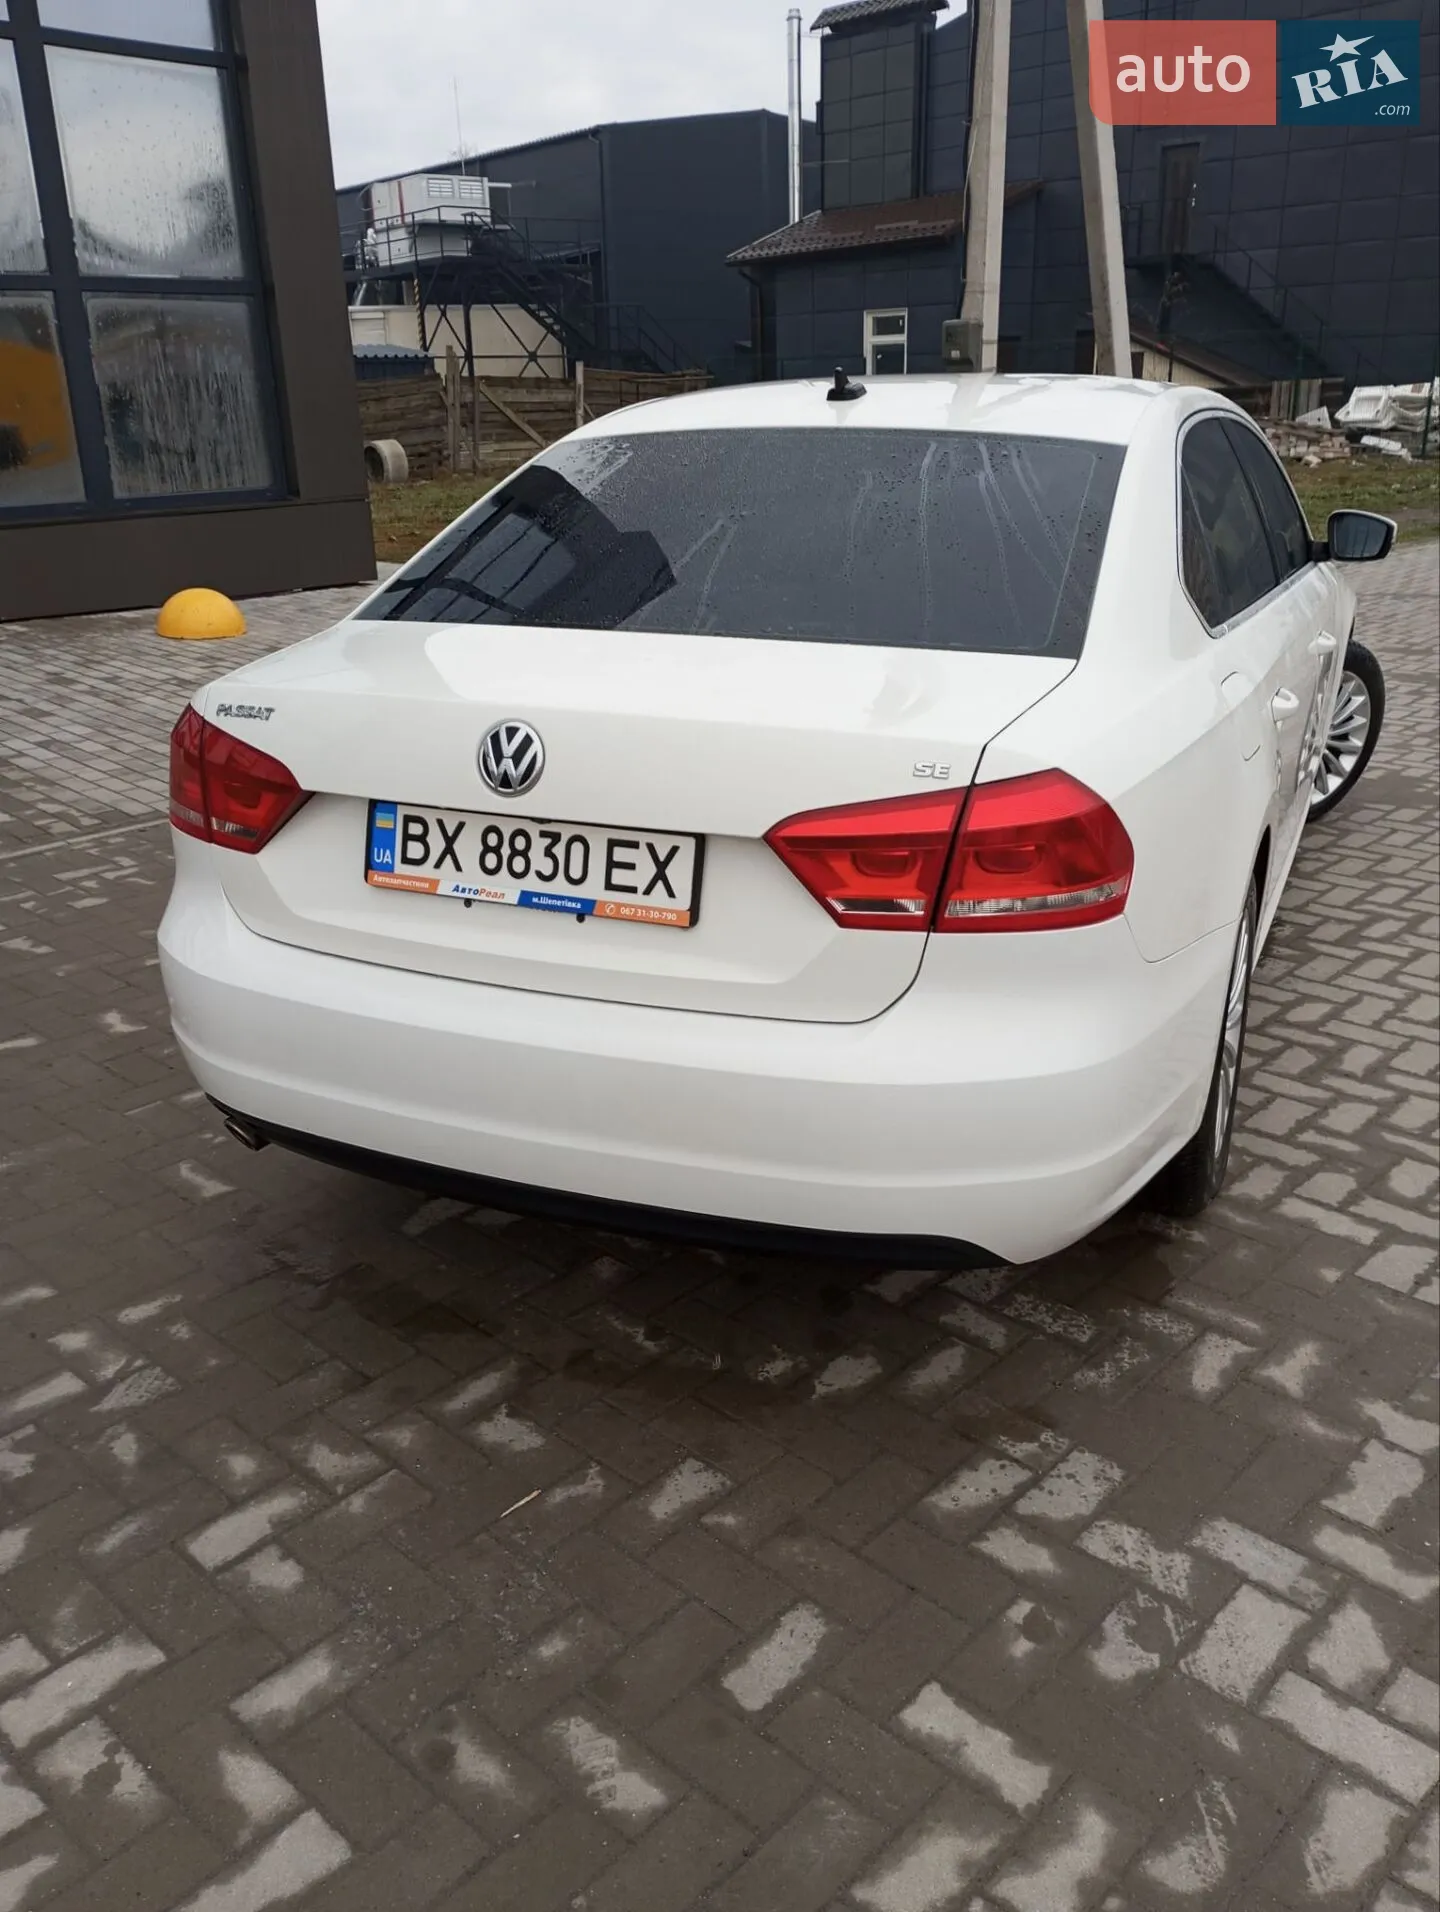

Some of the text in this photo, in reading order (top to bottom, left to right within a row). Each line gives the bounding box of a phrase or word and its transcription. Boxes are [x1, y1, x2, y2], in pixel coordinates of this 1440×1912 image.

[912, 761, 951, 780] SE
[373, 847, 393, 865] UA
[400, 814, 681, 899] BX 8830 EX
[452, 884, 506, 900] АвтоРеал
